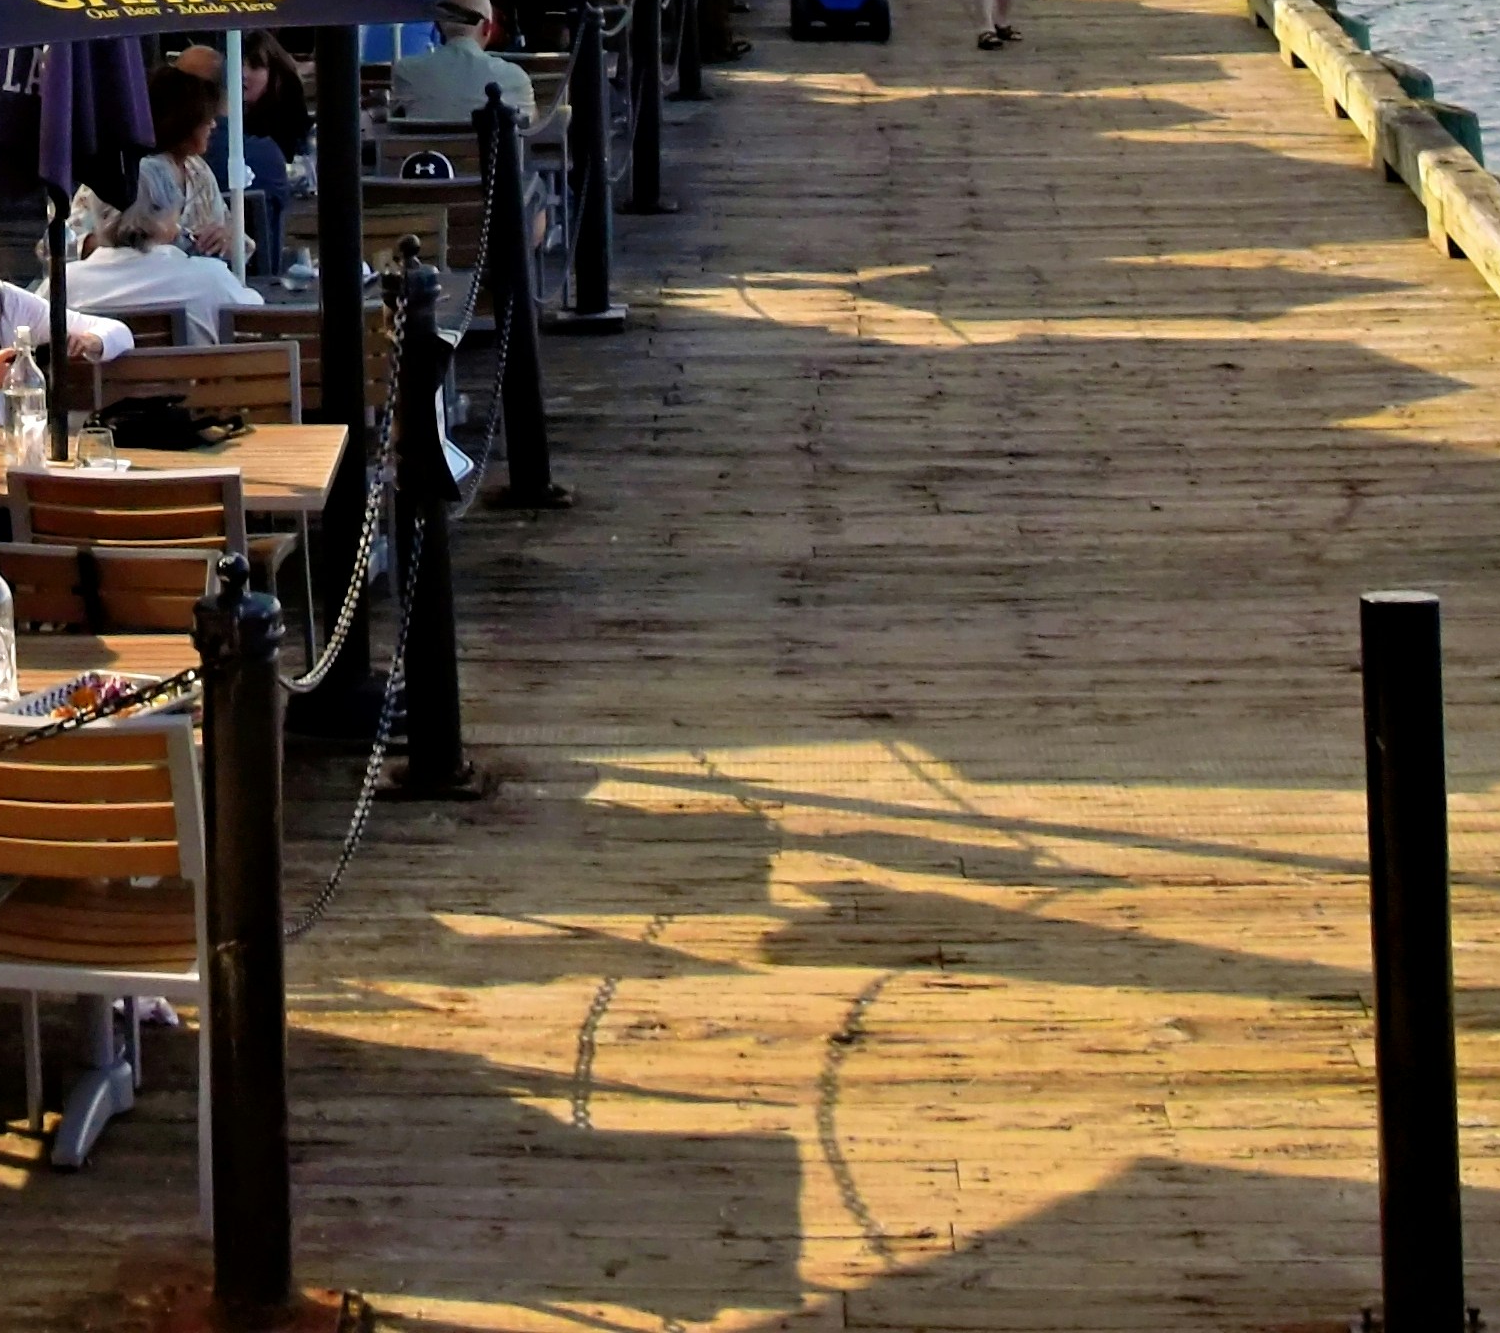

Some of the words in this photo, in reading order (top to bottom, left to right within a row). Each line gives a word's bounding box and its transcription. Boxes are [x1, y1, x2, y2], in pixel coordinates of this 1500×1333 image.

[86, 6, 120, 20] Our
[125, 4, 161, 17] Beer
[178, 2, 230, 16] Made
[234, 0, 277, 13] Here
